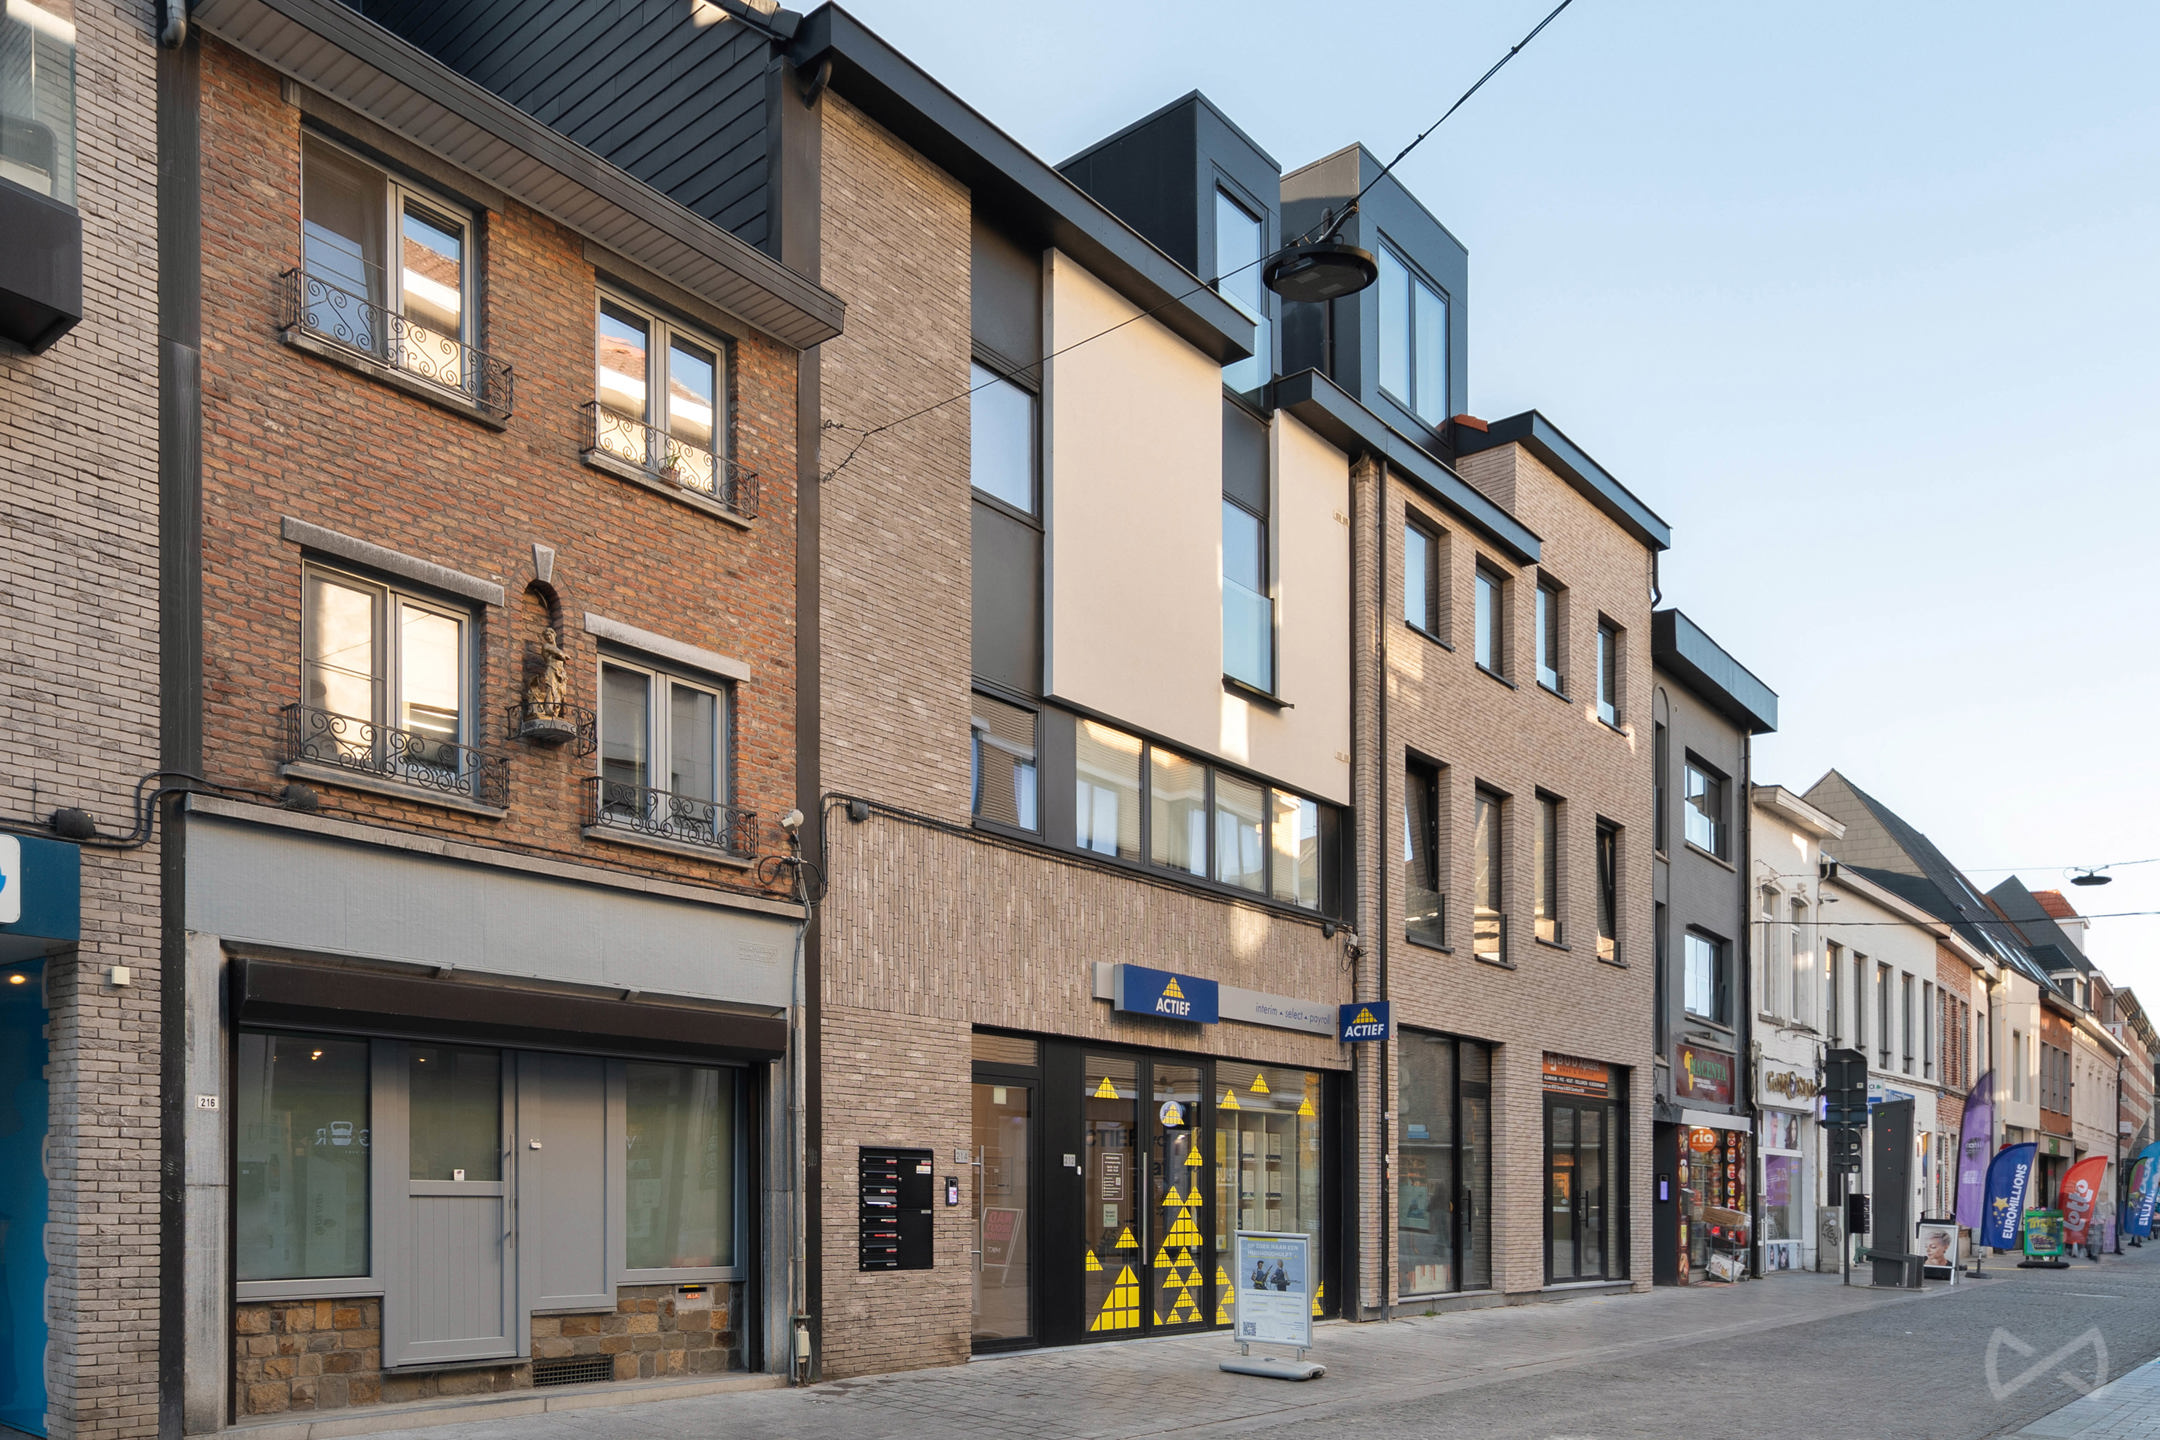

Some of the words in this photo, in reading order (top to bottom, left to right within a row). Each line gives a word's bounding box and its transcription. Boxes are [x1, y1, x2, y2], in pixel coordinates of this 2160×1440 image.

[1155, 997, 1190, 1016] ACTIEF
[1255, 1002, 1278, 1015] interim
[1285, 1007, 1303, 1020] select
[1309, 1013, 1331, 1025] payroll
[1344, 1023, 1385, 1038] ACTIEF
[1690, 1057, 1726, 1081] MACENTA
[200, 1098, 216, 1107] 216
[1692, 1130, 1714, 1144] ria
[2002, 1163, 2028, 1239] EUROMILLIONS
[2063, 1179, 2094, 1232] Lotto
